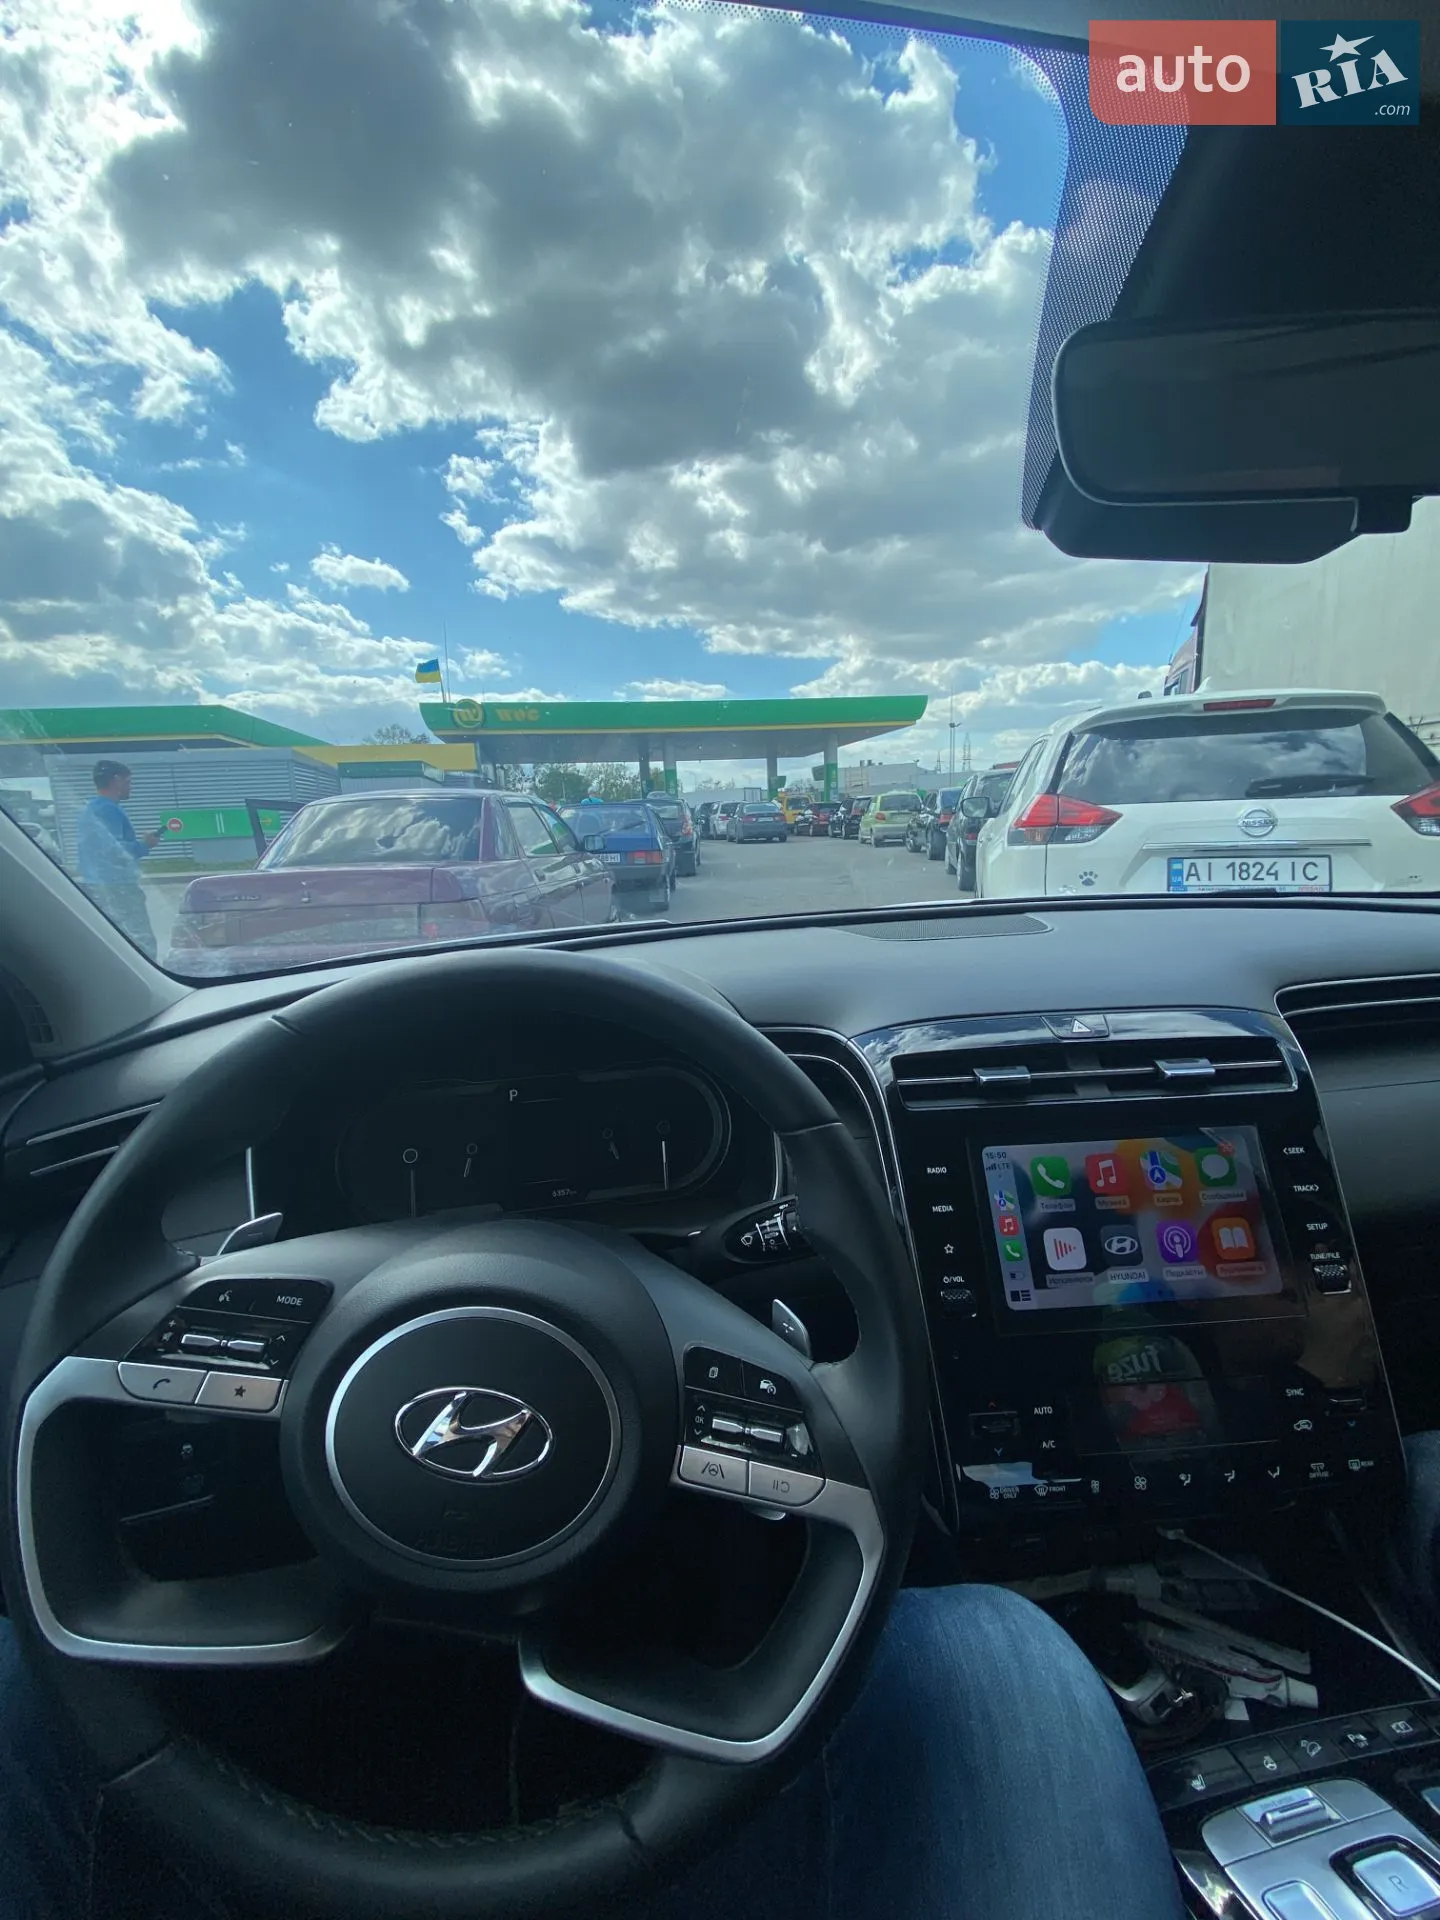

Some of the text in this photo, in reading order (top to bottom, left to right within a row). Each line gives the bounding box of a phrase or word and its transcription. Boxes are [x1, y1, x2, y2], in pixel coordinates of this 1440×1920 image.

[1185, 861, 1319, 881] AI 1824 IC
[509, 1088, 518, 1102] P
[985, 1151, 1007, 1160] 15:50
[927, 1166, 948, 1174] RADIO
[932, 1205, 954, 1213] MEDIA
[1306, 1223, 1328, 1231] SETUP
[1110, 1272, 1146, 1281] HYUNDAI
[276, 1295, 304, 1306] MODE
[1285, 1388, 1305, 1397] SYNC
[1033, 1406, 1053, 1415] AUTO
[1042, 1440, 1056, 1449] A/C
[1388, 1874, 1410, 1892] R
